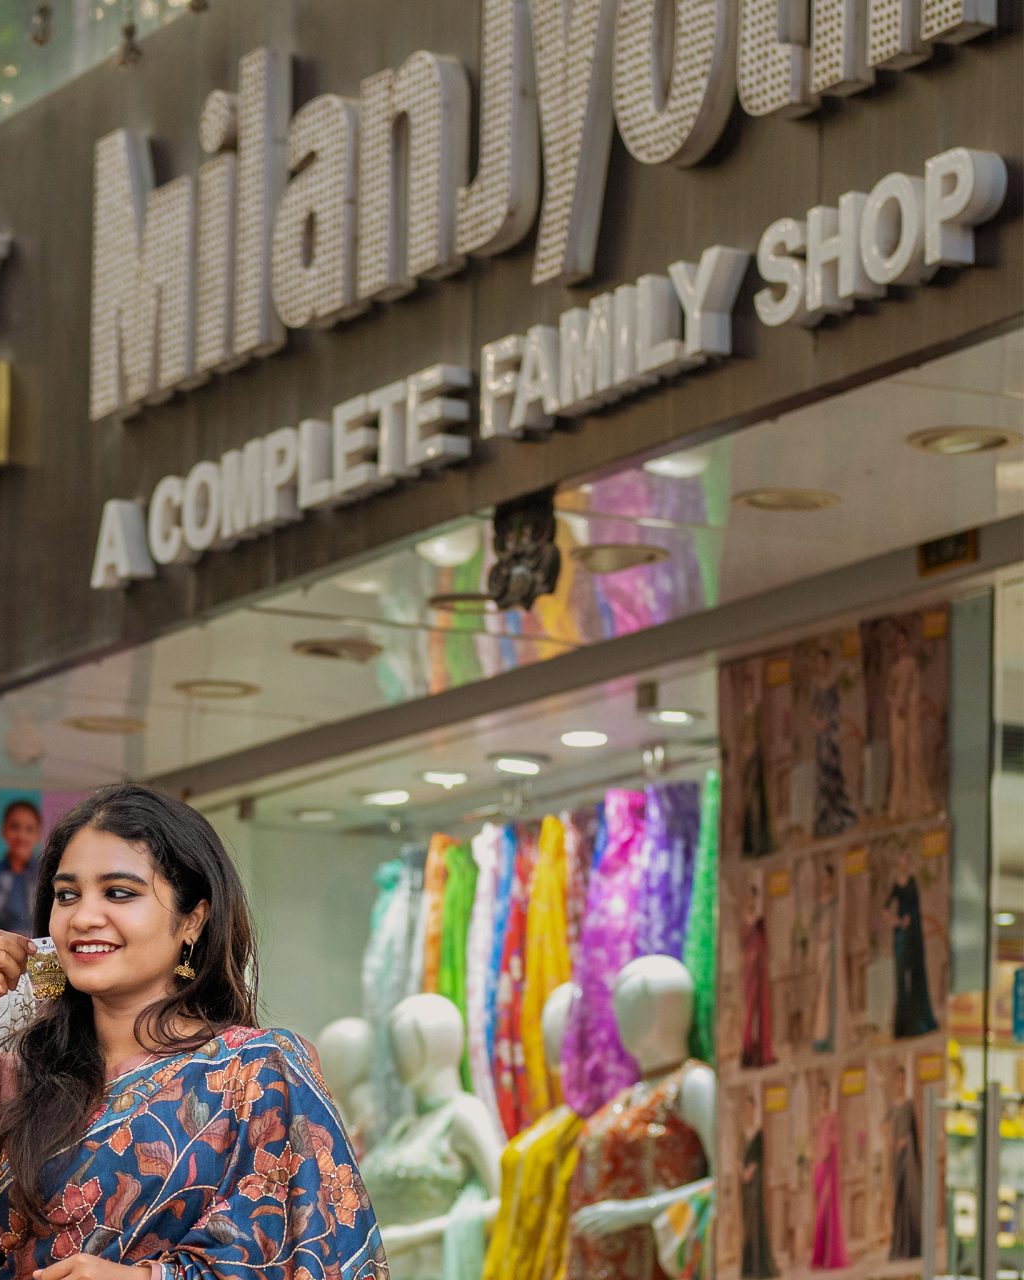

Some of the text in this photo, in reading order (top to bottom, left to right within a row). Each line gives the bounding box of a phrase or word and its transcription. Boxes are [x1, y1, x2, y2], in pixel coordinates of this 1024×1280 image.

[90, 147, 1007, 589] A COMPLETE FAMILY SHOP
